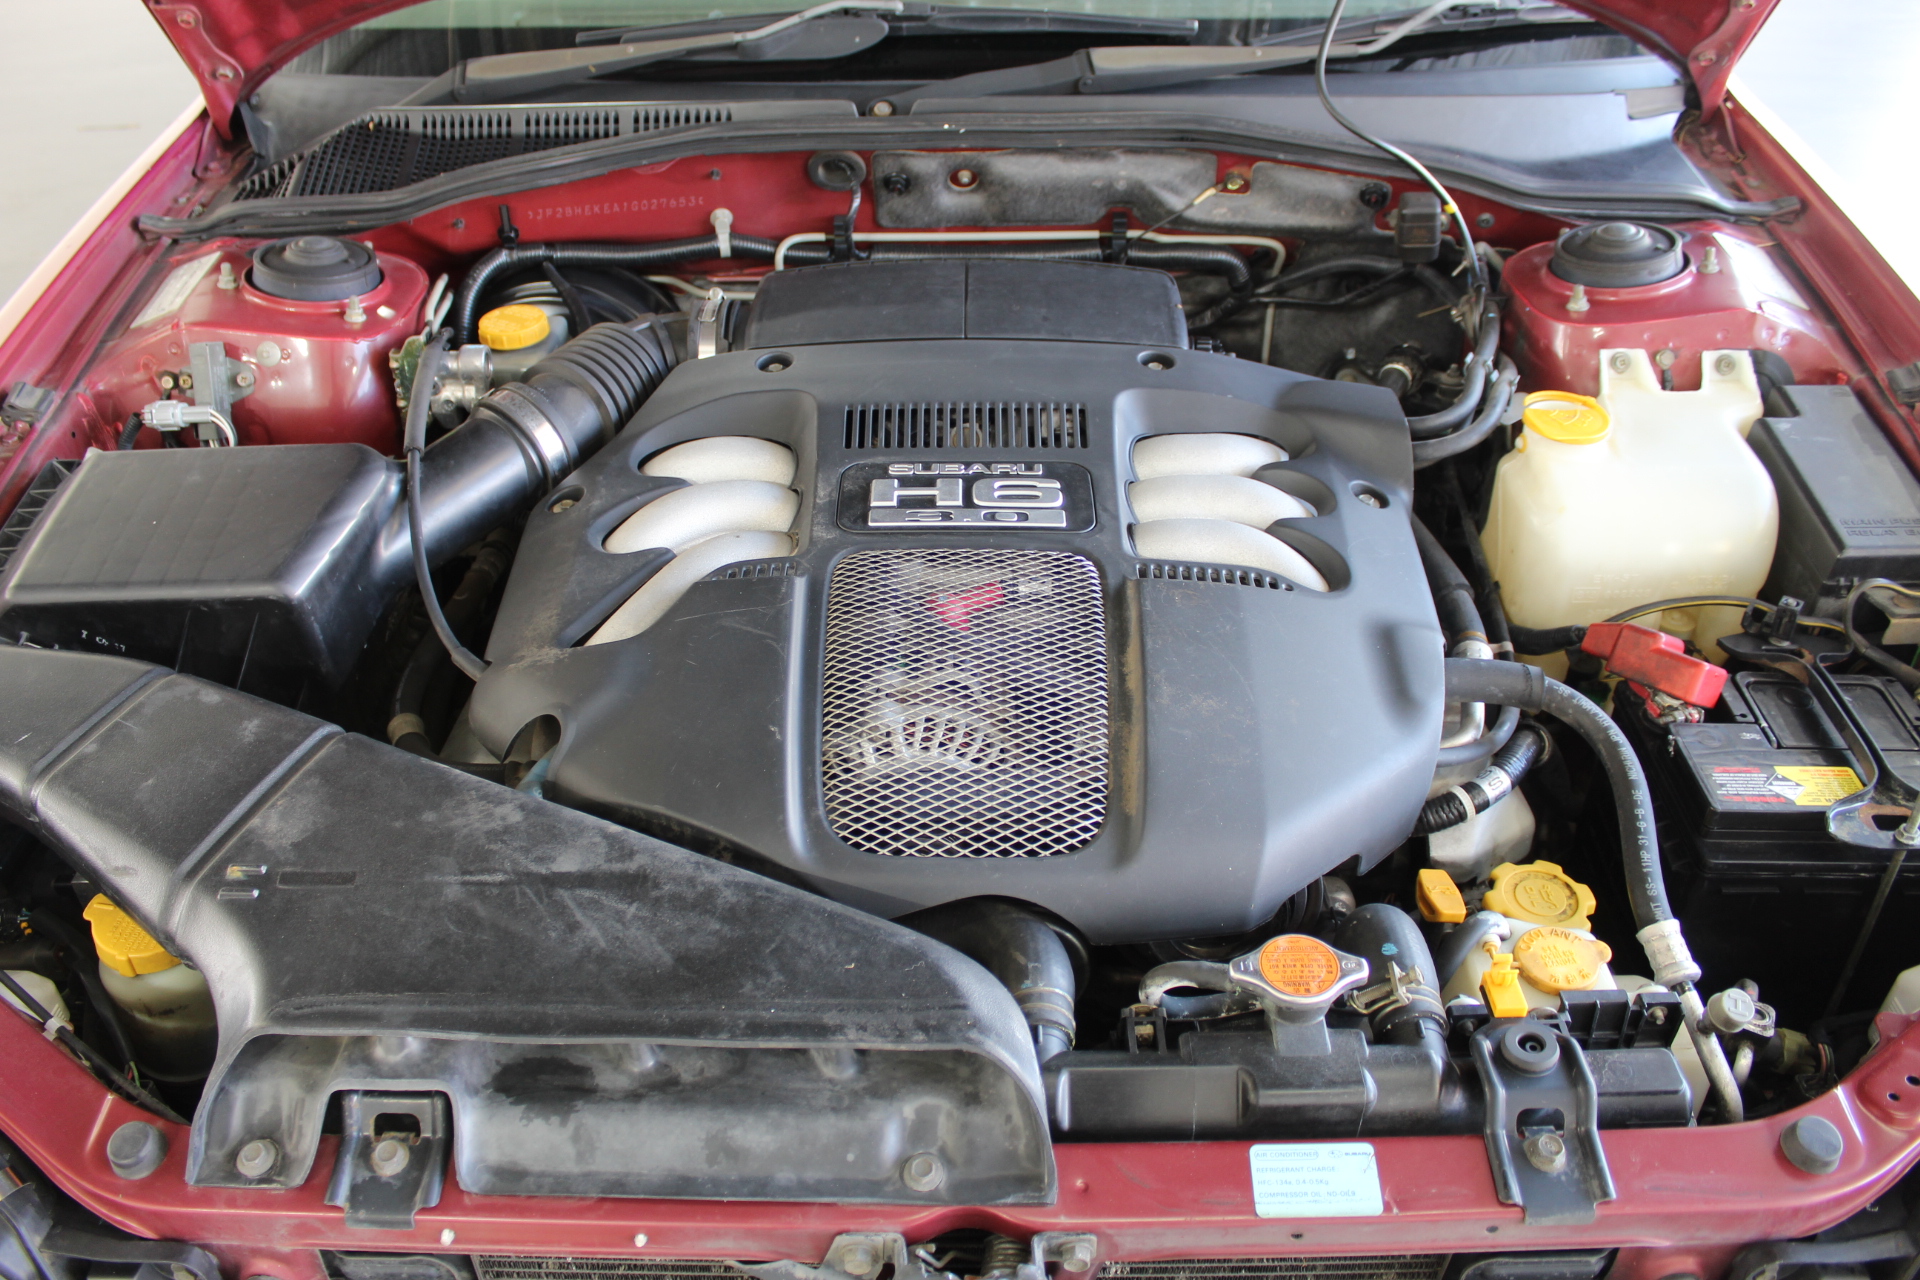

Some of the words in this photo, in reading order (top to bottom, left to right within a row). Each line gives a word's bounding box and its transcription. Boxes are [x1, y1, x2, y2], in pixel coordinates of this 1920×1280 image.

[888, 463, 1043, 474] SUBARU
[870, 478, 1063, 507] H6
[905, 510, 1029, 522] 3.0
[1889, 518, 1920, 526] FUS
[1607, 730, 1623, 744] JPN
